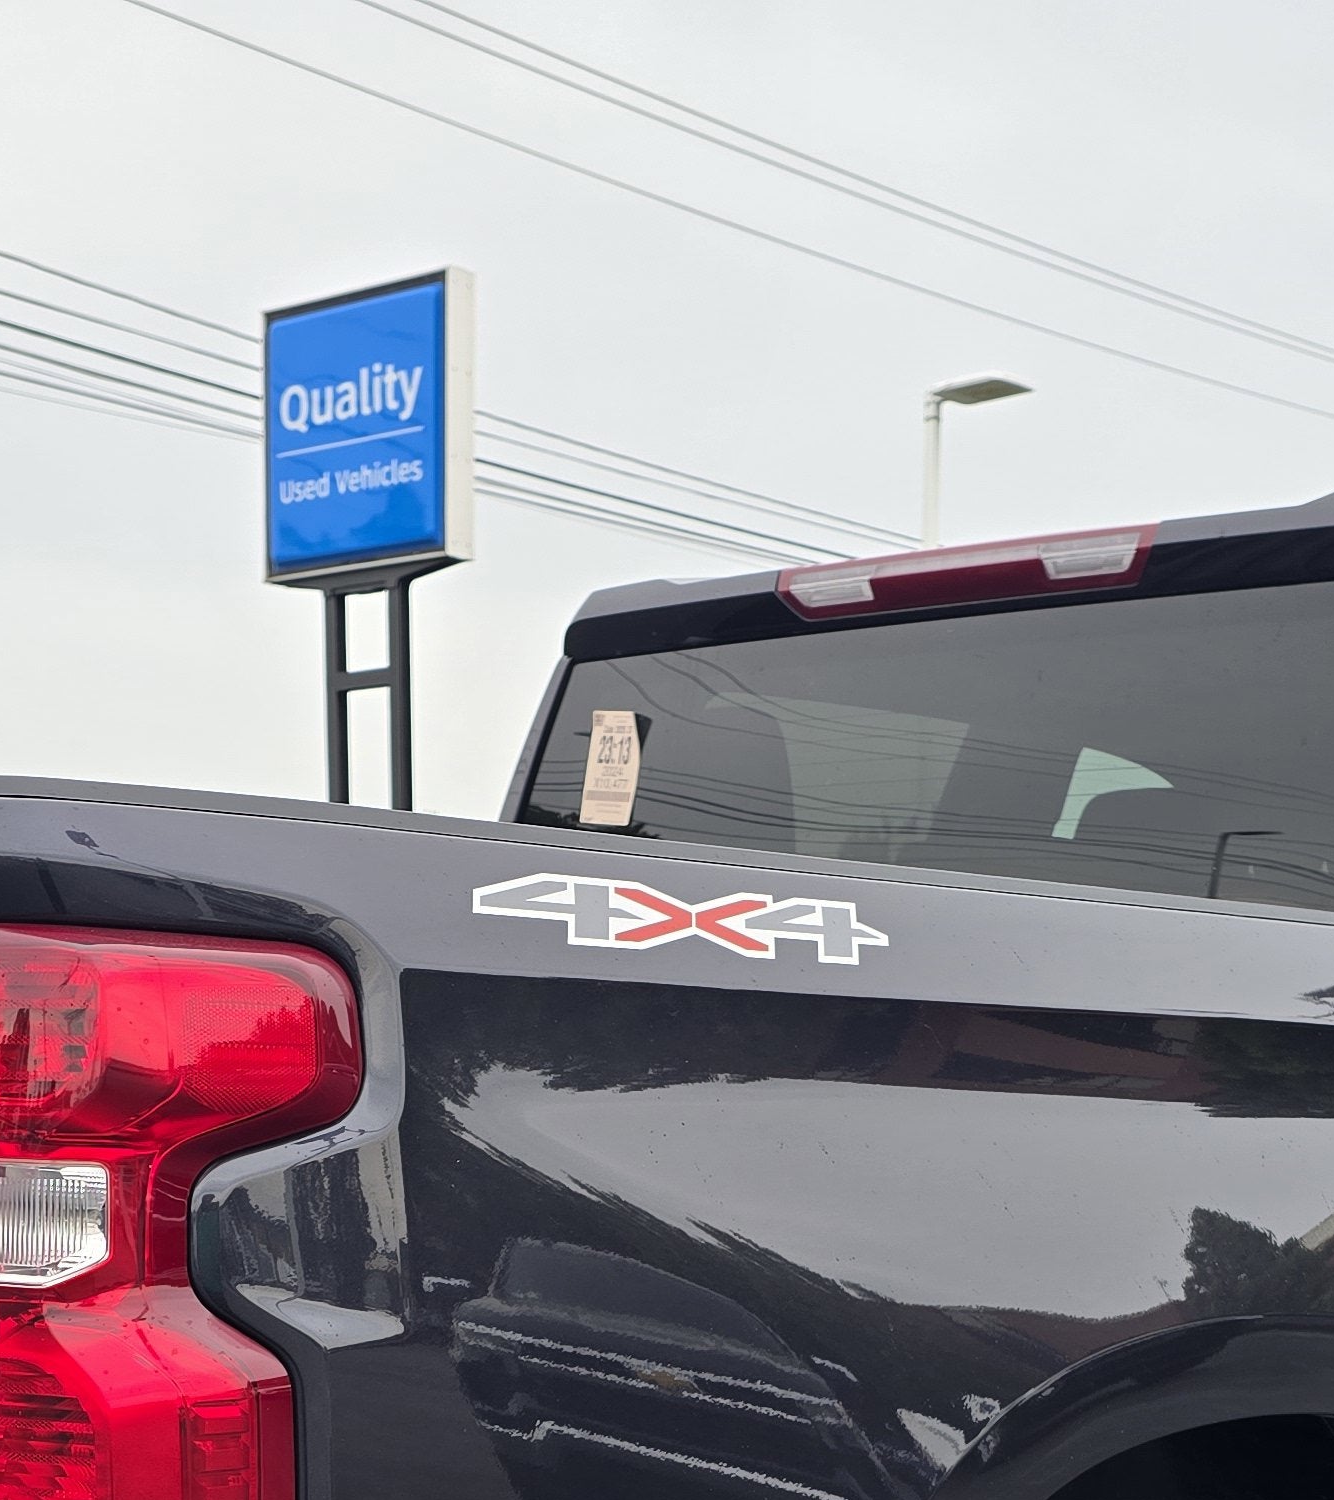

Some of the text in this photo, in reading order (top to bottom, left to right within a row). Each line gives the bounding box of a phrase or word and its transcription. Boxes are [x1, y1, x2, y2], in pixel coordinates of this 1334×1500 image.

[279, 362, 424, 433] Quality
[279, 458, 424, 504] Used Vehicles
